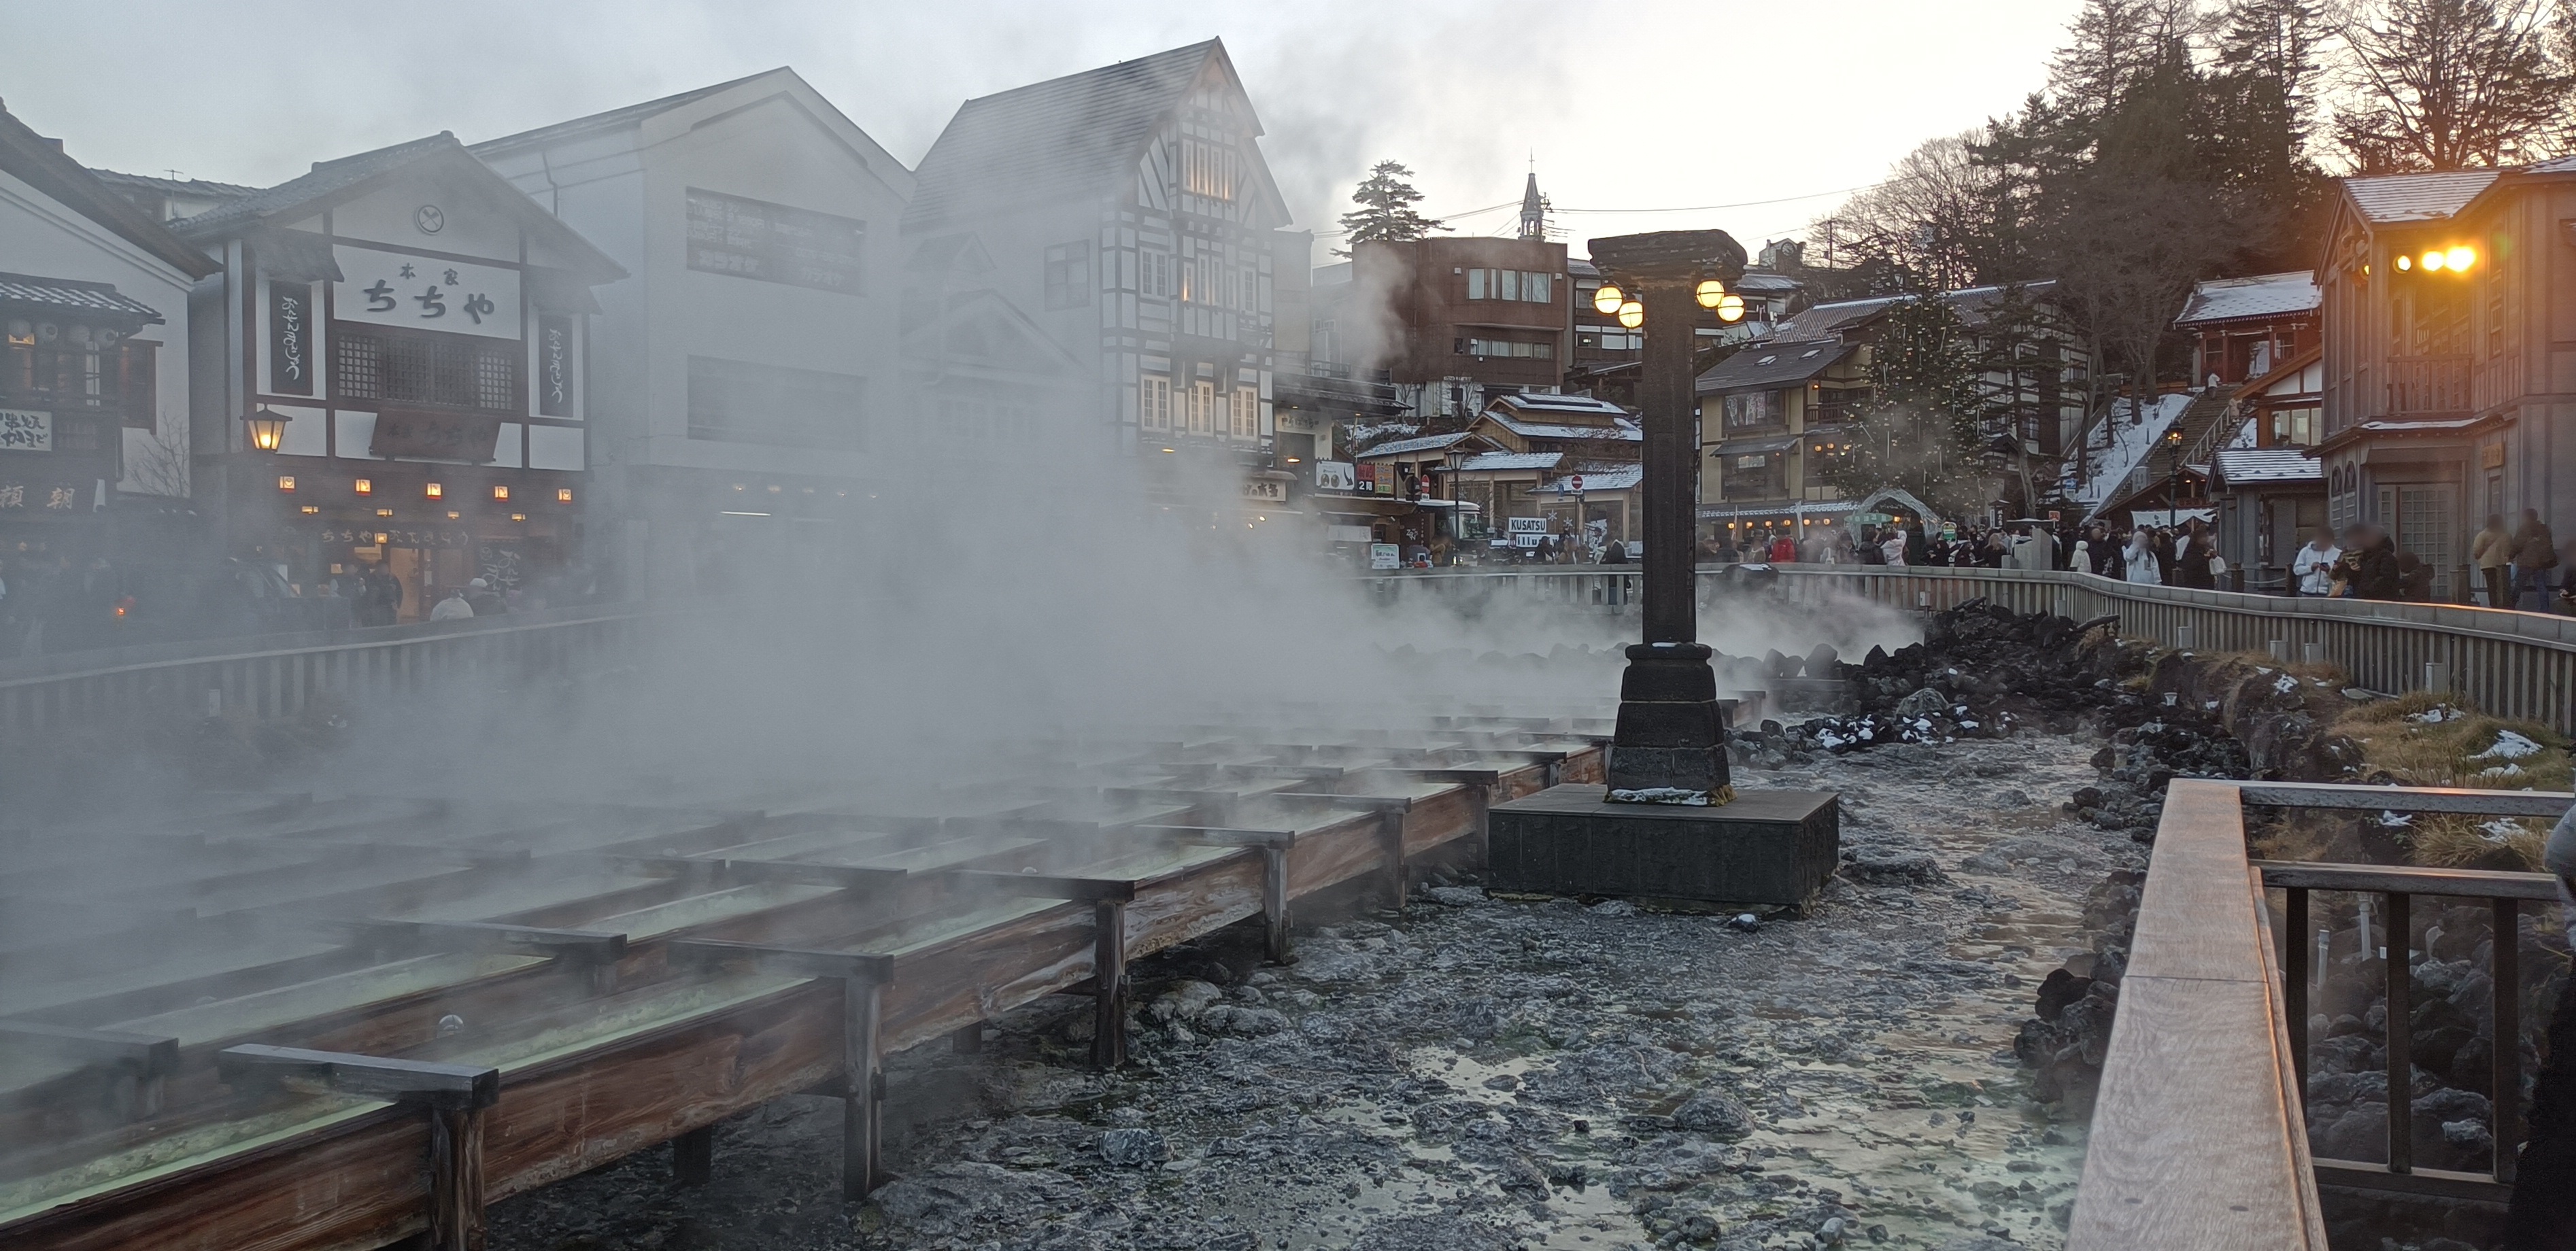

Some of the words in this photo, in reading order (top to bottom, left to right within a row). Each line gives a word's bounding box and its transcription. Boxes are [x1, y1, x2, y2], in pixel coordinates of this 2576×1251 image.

[399, 262, 460, 286] 本家
[363, 279, 495, 325] ちちや
[1511, 519, 1546, 531] KUSATSU
[322, 529, 372, 543] ちちや
